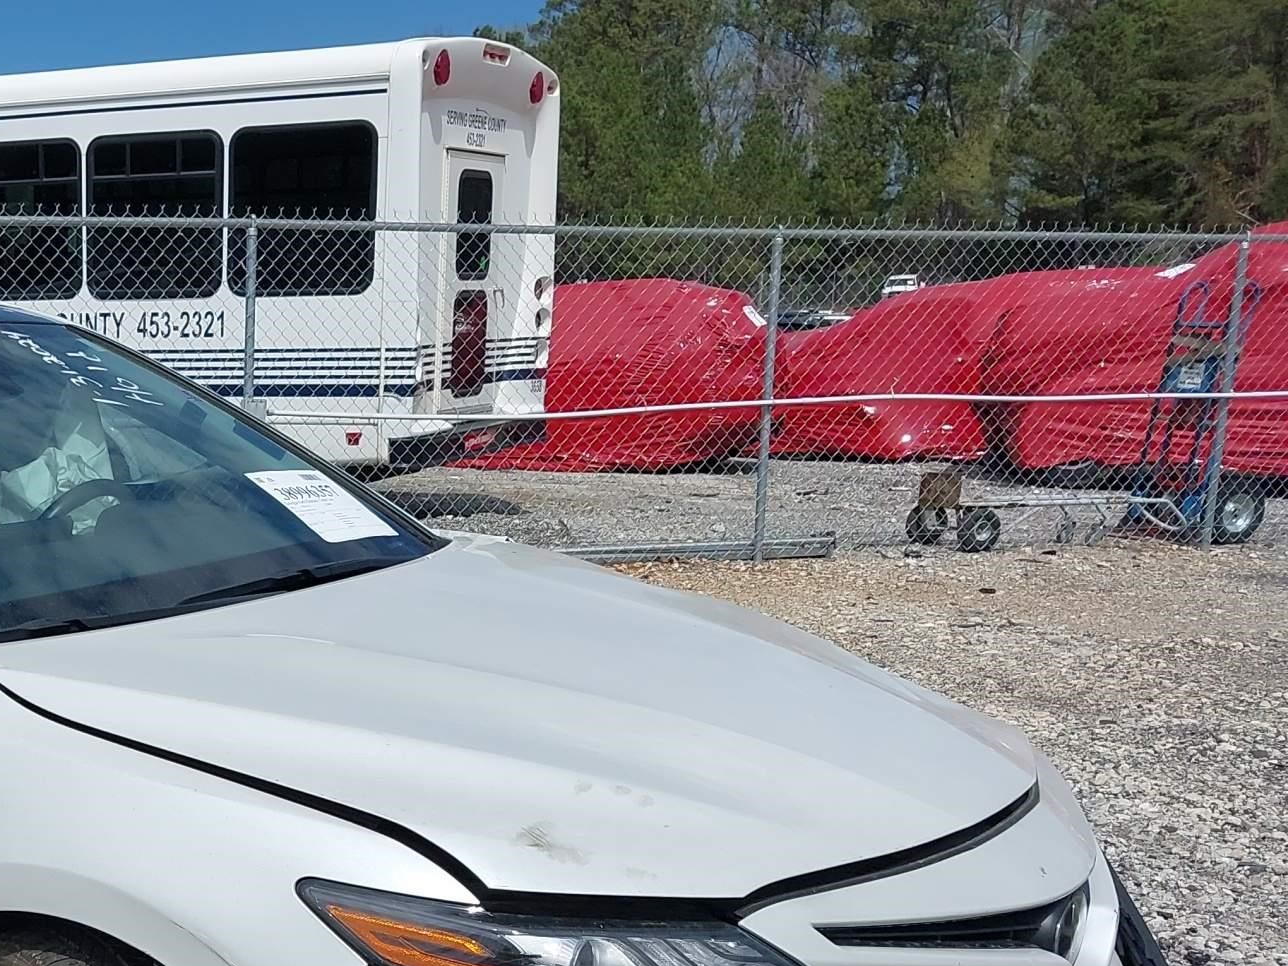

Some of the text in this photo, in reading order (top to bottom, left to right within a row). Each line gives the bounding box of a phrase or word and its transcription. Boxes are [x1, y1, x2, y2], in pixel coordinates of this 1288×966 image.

[446, 109, 507, 133] SERVING GREENE COUNTY
[136, 310, 225, 339] 453-2321
[273, 484, 340, 502] 38996357
